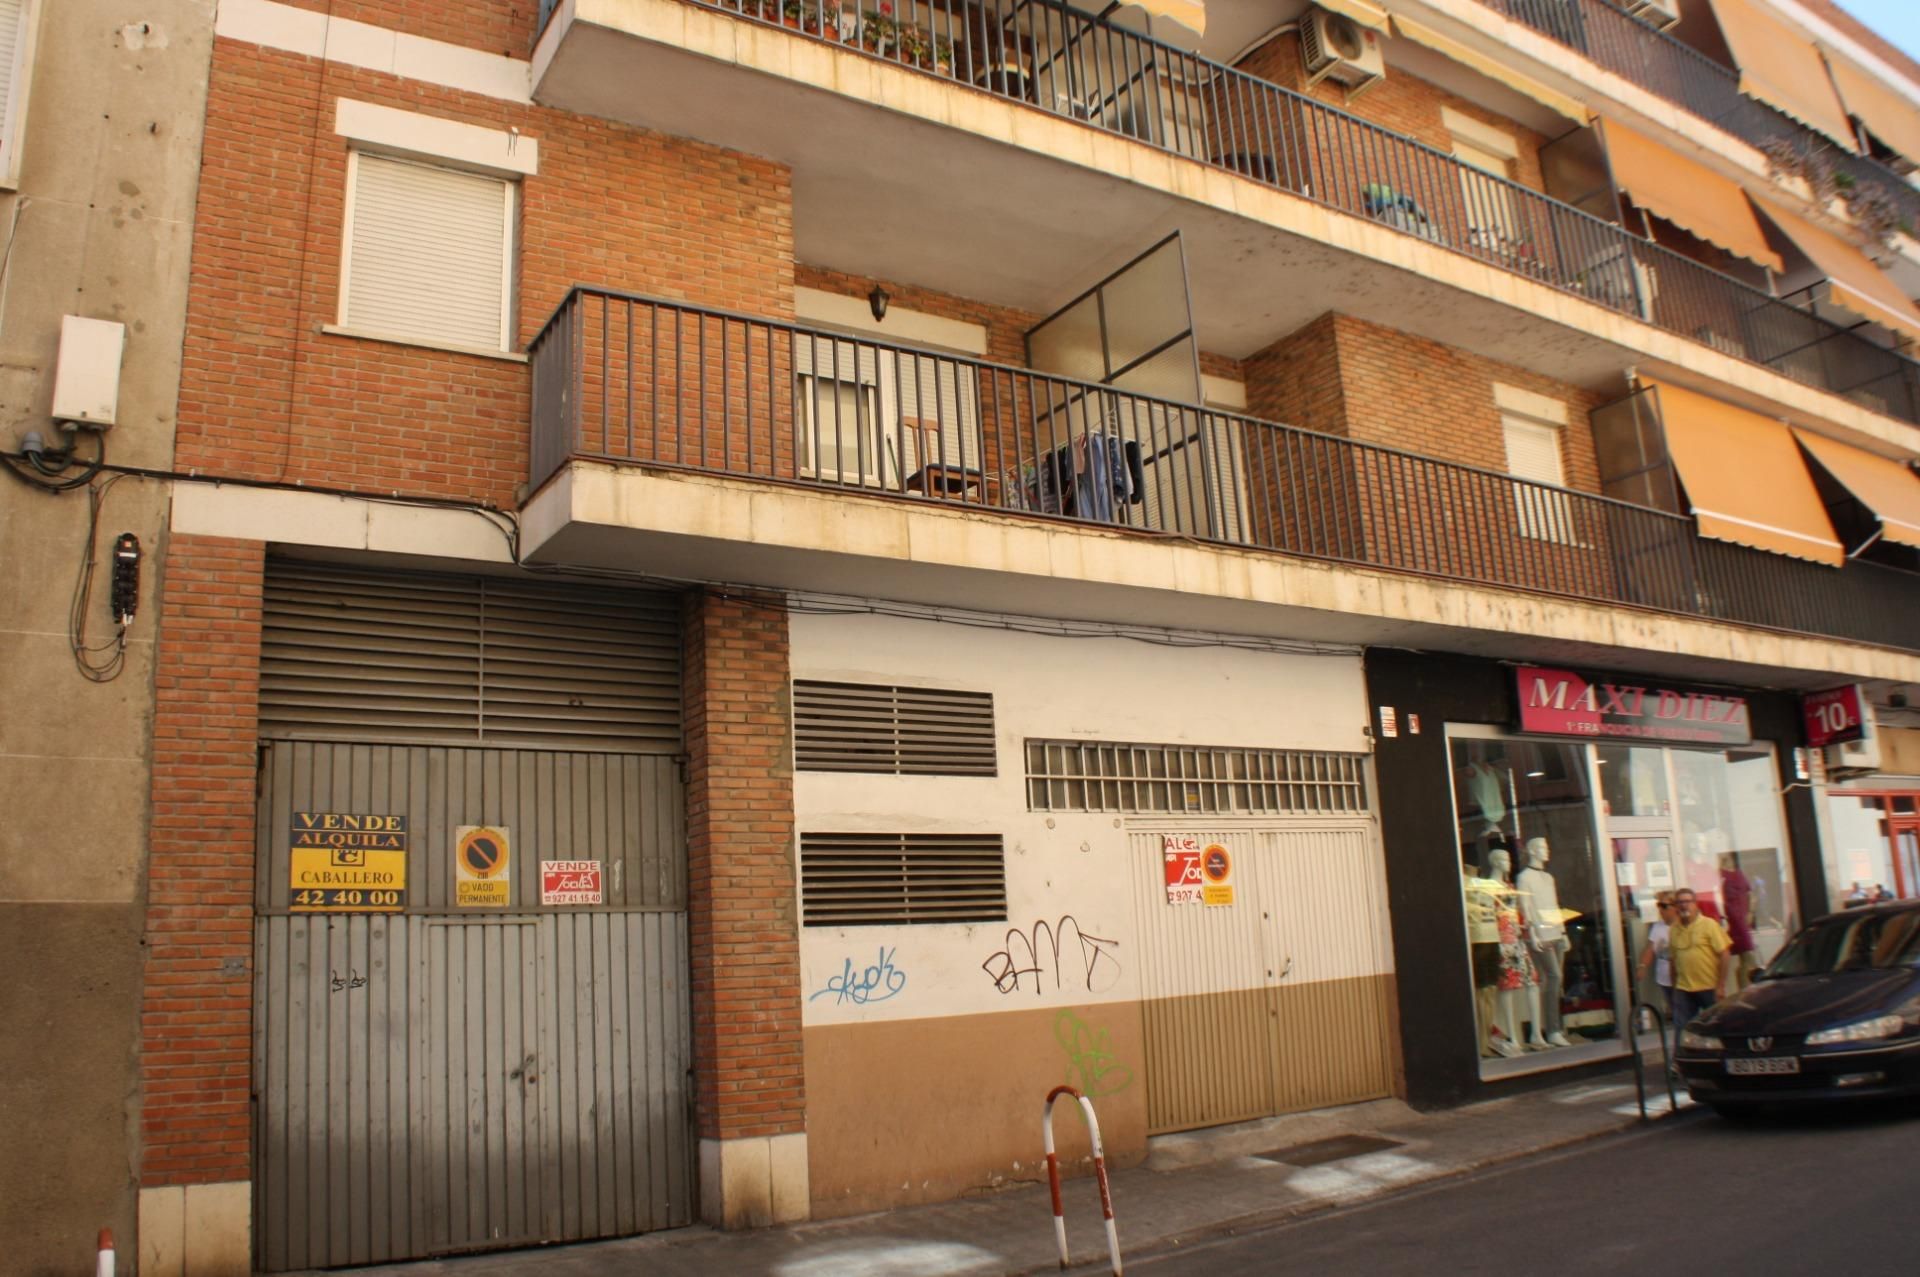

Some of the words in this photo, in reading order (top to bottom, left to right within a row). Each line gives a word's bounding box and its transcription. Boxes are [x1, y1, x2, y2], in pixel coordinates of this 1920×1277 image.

[1529, 677, 1647, 716] MAXI
[1654, 689, 1746, 725] DIEZ
[301, 813, 401, 831] VENDE
[297, 832, 400, 848] ALQUILA
[545, 862, 598, 871] VENDE
[301, 871, 394, 884] CABALLERO
[472, 883, 494, 892] VADO
[296, 889, 325, 905] 42
[333, 890, 362, 905] 40
[370, 890, 399, 905] 00
[460, 894, 505, 904] PERMANENTE
[552, 894, 566, 903] 927
[568, 894, 577, 902] 41
